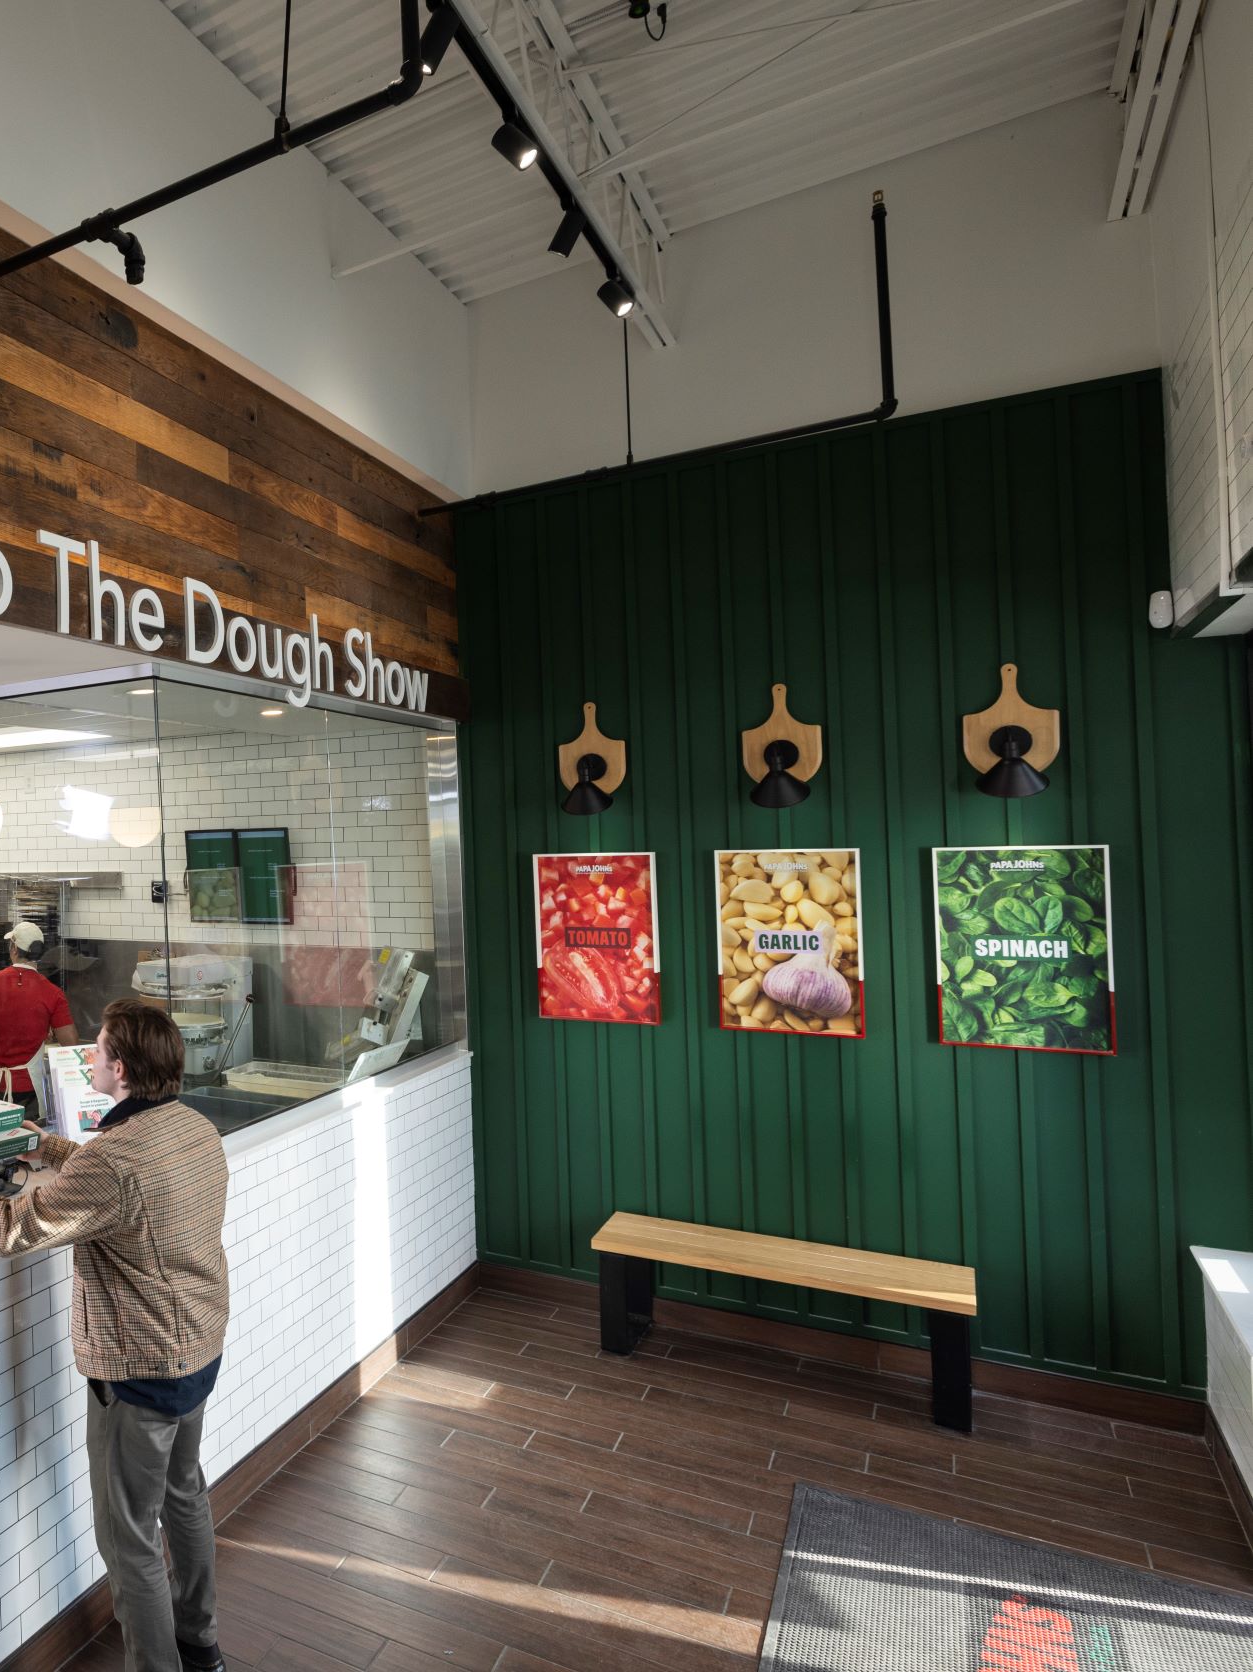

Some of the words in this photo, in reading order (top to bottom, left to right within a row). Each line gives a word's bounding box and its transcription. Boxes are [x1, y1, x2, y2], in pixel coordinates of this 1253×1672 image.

[36, 529, 165, 651] The
[182, 576, 335, 708] Dough
[344, 628, 429, 712] Show
[990, 860, 1014, 869] PAPA
[1013, 859, 1044, 869] JOHNS
[567, 930, 628, 946] TOMATO
[758, 933, 820, 951] GARLIC
[974, 938, 1069, 959] SPINACH
